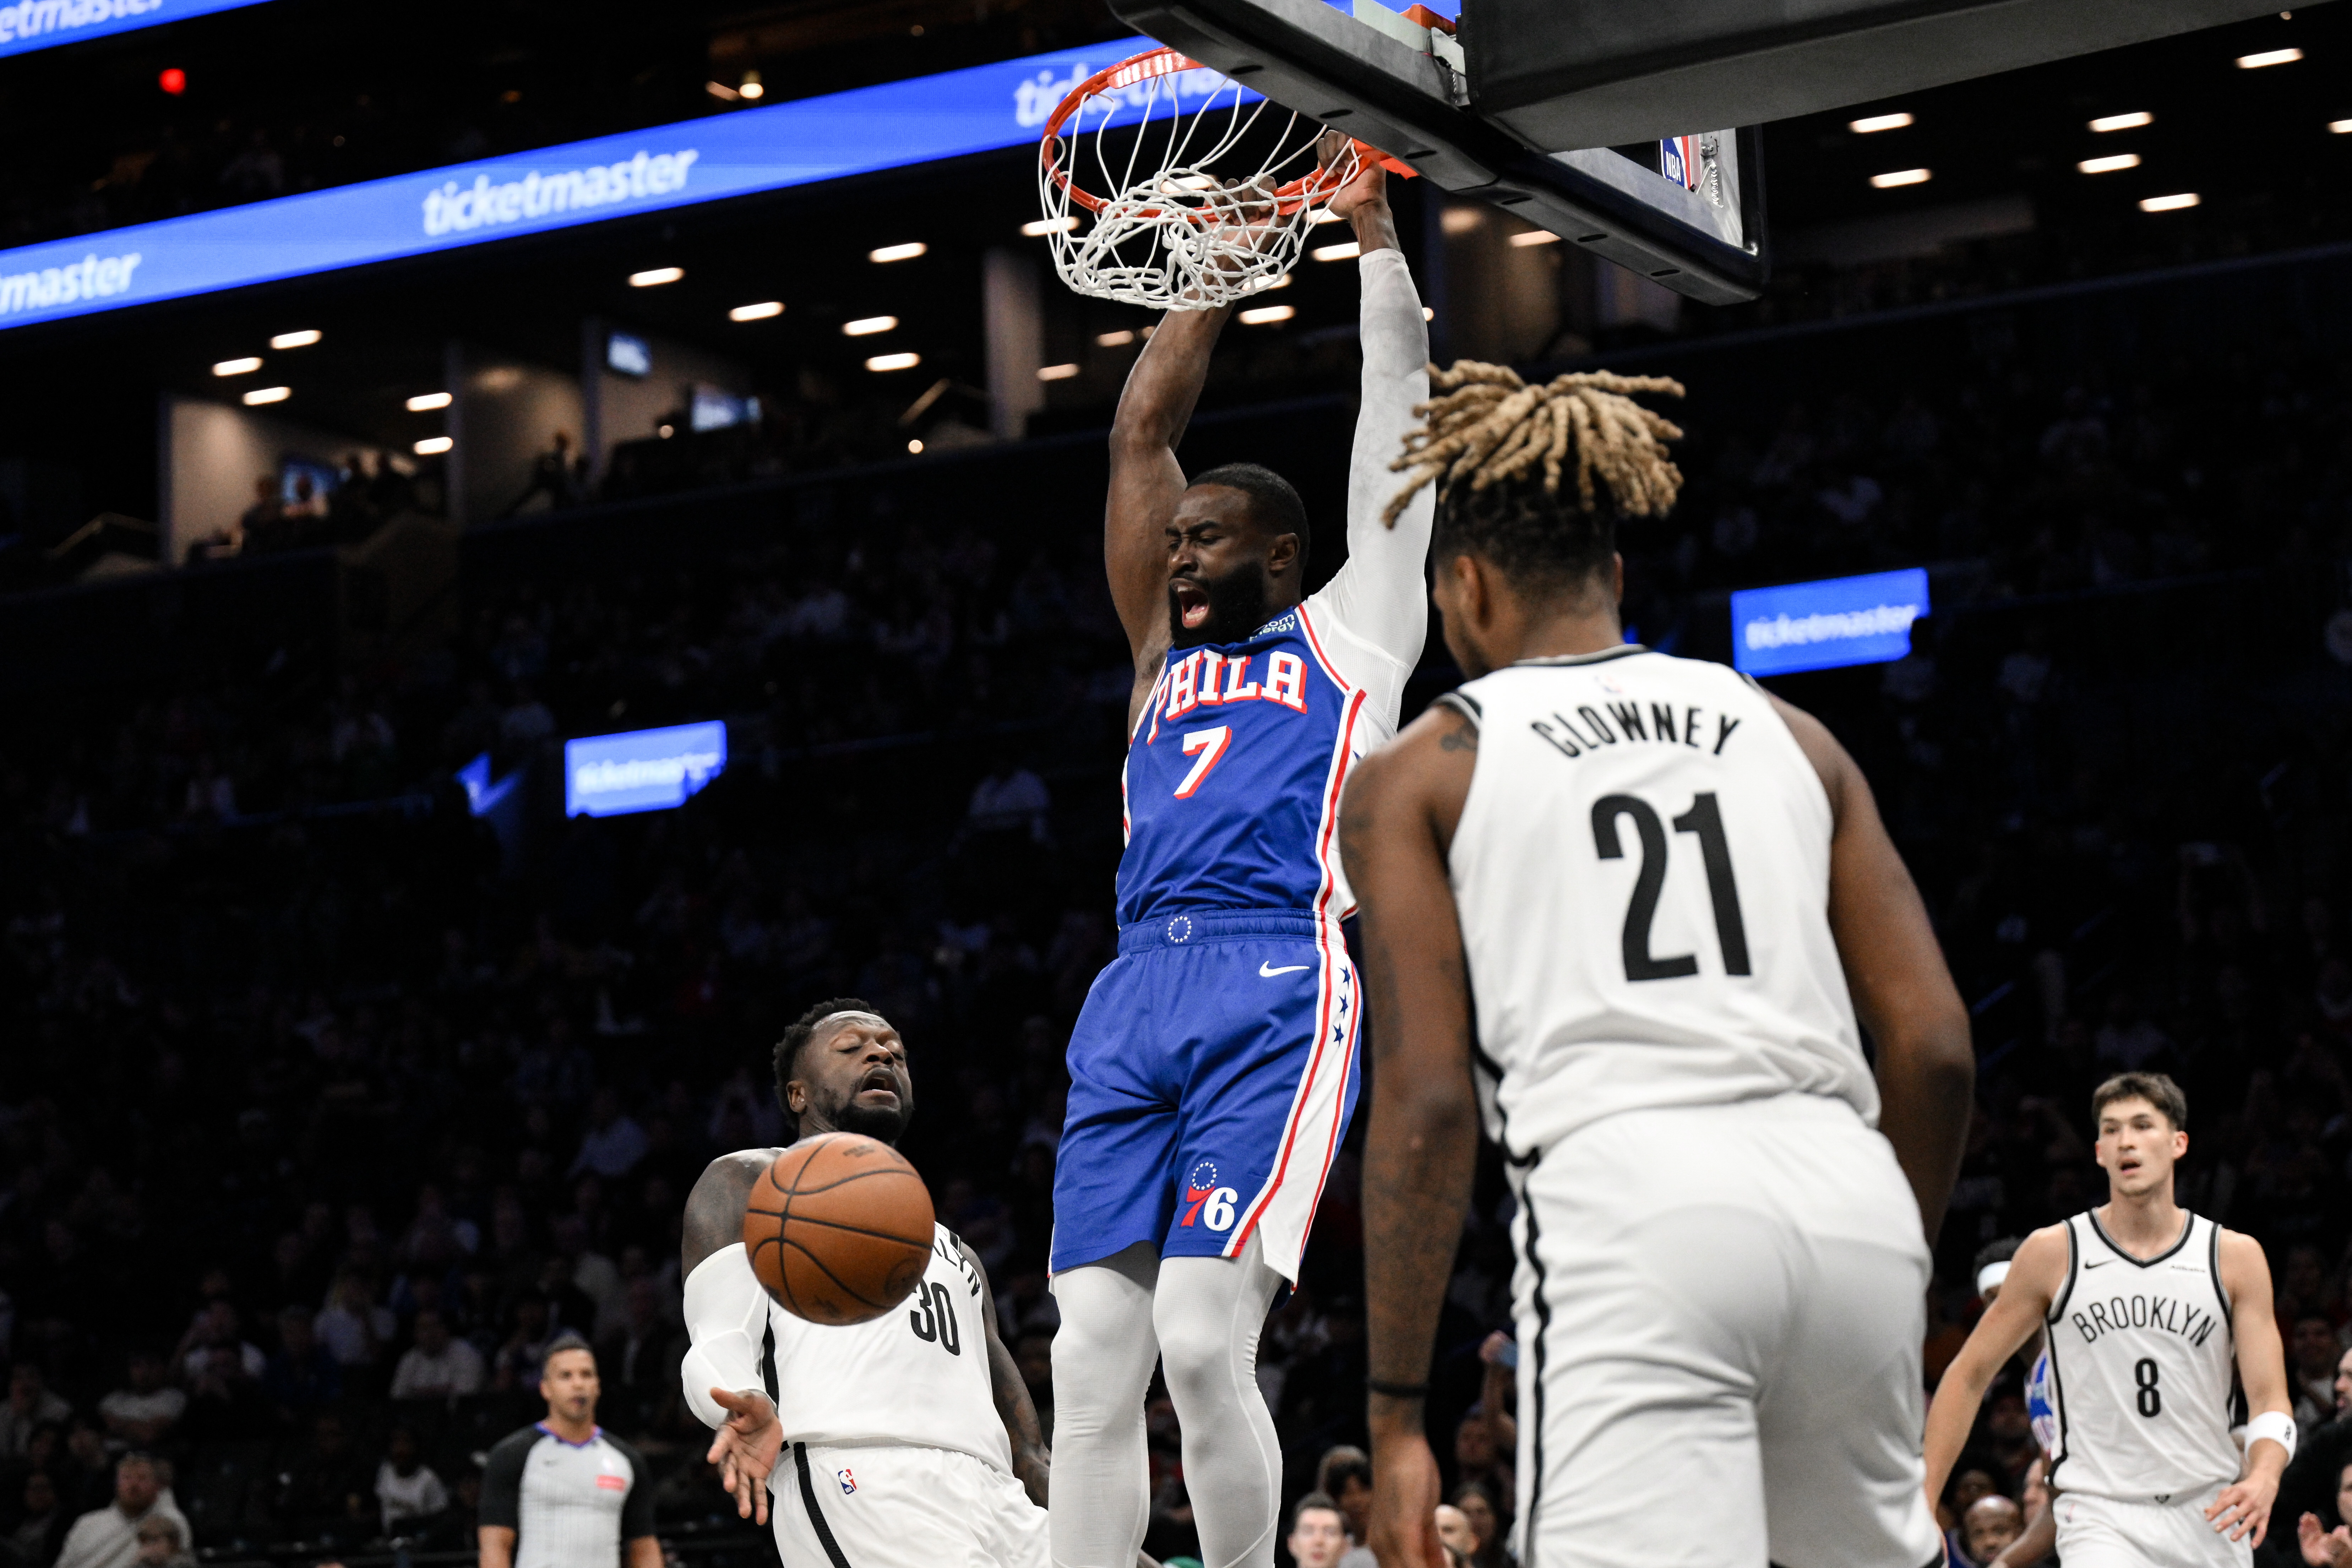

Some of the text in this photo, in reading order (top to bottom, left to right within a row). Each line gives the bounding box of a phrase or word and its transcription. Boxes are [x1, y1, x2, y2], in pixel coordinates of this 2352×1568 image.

[423, 148, 699, 236] ticketmaster
[1666, 151, 1681, 182] NBA
[1147, 649, 1307, 745] PHILA
[1531, 701, 1741, 758] CLOWNEY
[1174, 725, 1232, 800] 7
[1591, 790, 1752, 983] 21
[1181, 1186, 1238, 1231] 76
[910, 1278, 960, 1356] 30
[2073, 1295, 2216, 1347] BROOKLYN
[2135, 1358, 2161, 1417] 8
